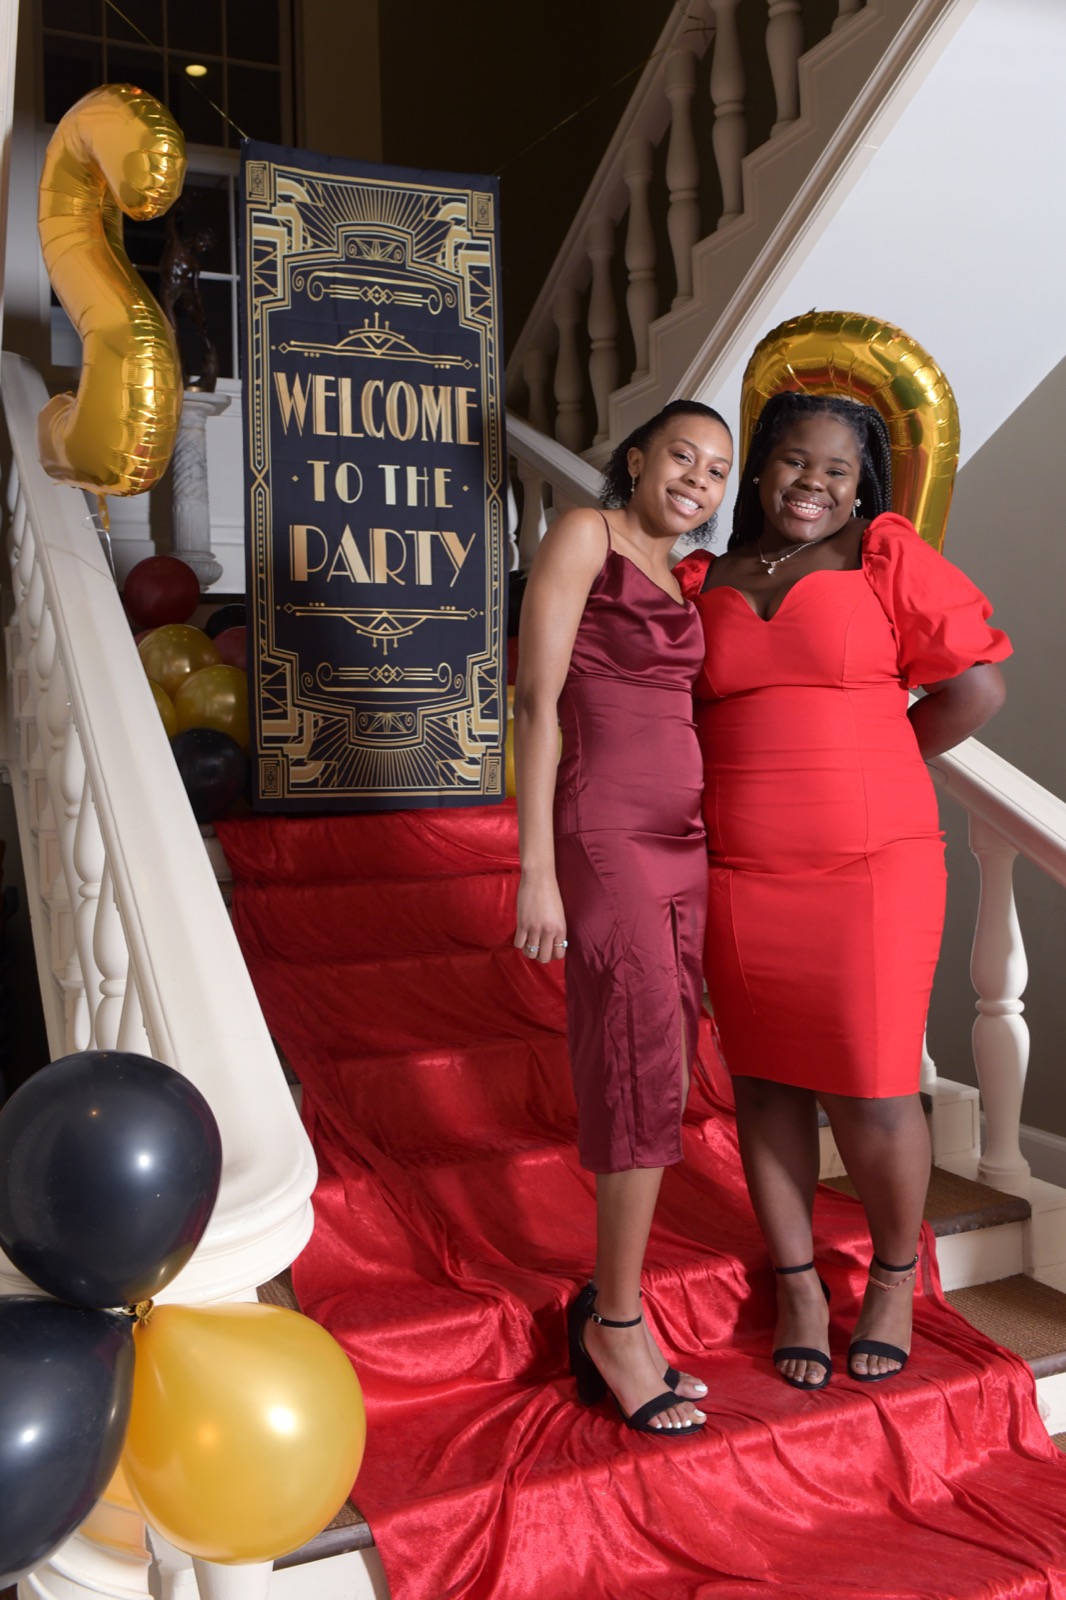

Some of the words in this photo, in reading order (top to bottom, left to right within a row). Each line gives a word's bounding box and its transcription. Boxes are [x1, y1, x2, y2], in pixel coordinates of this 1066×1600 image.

[273, 371, 480, 445] WELCOME
[307, 460, 363, 504] TO
[378, 464, 453, 508] THE
[289, 524, 476, 588] PARTY
